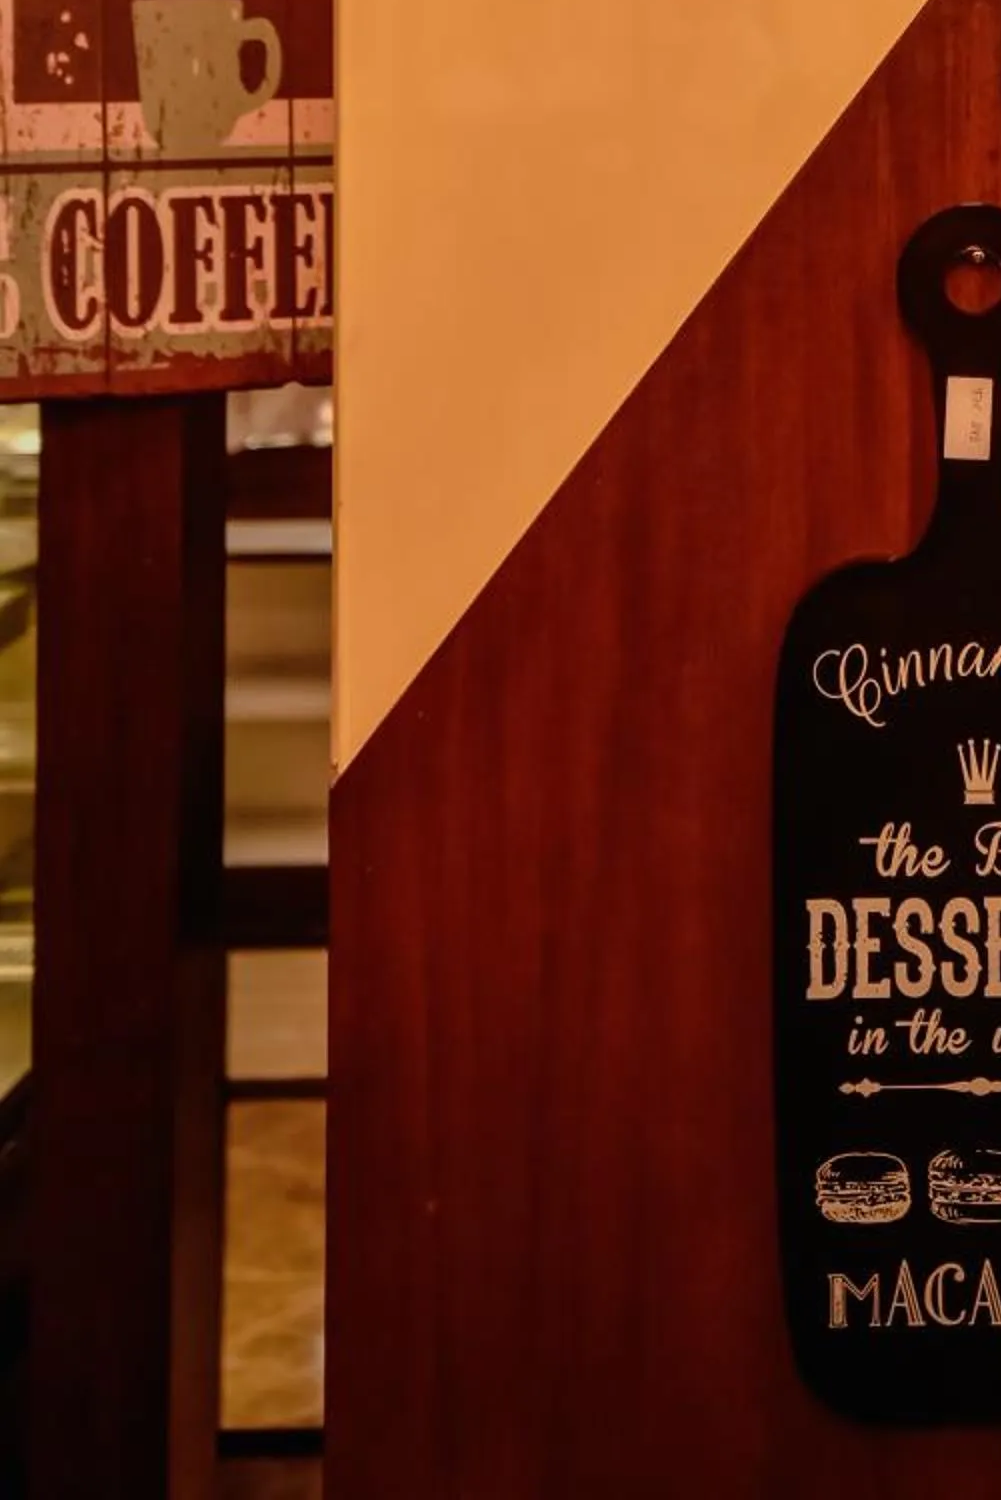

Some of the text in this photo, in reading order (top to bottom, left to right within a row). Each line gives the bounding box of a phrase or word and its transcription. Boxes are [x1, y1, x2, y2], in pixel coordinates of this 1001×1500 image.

[45, 190, 334, 332] COFFE
[858, 821, 951, 878] the
[848, 1015, 889, 1055] in
[895, 1008, 972, 1055] the
